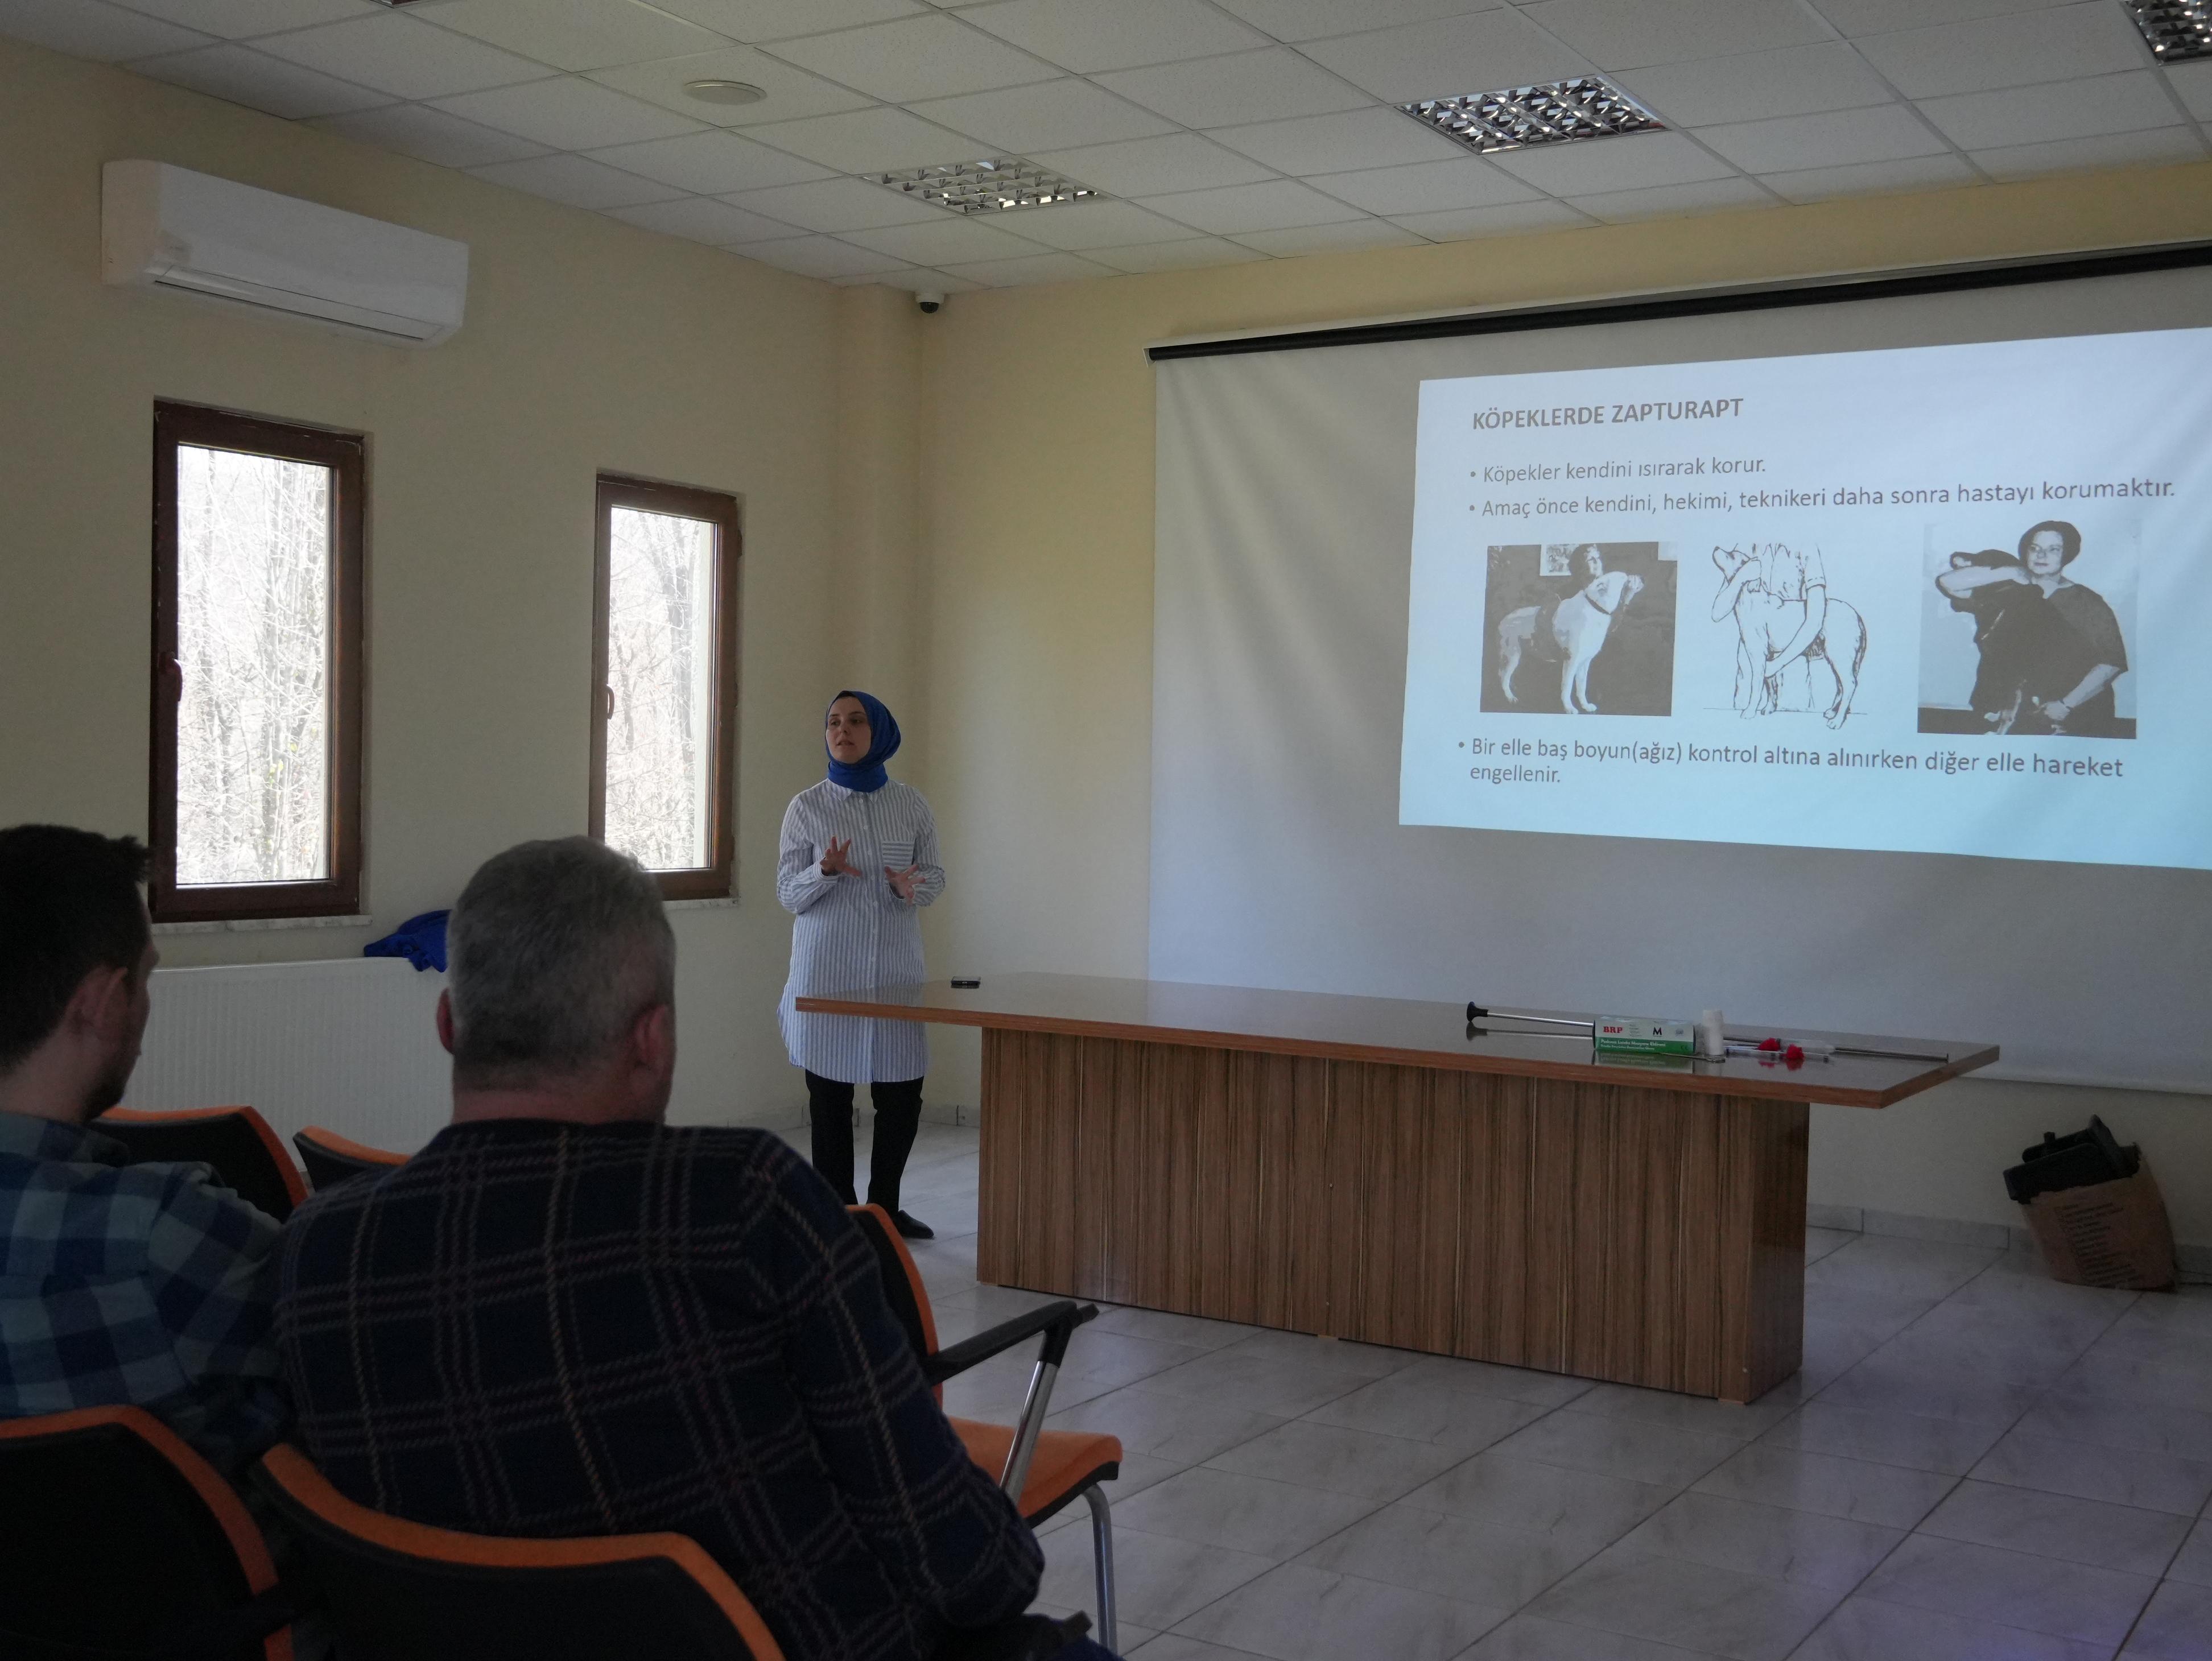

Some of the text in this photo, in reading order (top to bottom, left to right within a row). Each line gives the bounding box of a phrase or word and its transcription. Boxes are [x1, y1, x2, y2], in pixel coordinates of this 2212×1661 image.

[1473, 398, 1744, 430] KÖPEKLERDE ZAPTURAPT
[1484, 456, 1766, 486] Köpekler kendini ısırarak korur.
[1481, 477, 2175, 519] Amaç önce kendini, hekimi, teknikeri daha sonra hastayı korumaktır.
[1472, 738, 1496, 755] Bir
[1501, 738, 1532, 756] elle
[1538, 739, 1568, 761] baş
[1689, 743, 1757, 763] kontrol
[1764, 745, 1820, 766] altına
[1827, 747, 1917, 770] alınırken
[1925, 751, 1980, 775] diğer
[1986, 752, 2025, 772] elle
[2033, 753, 2123, 777] hareket
[1470, 764, 1561, 785] engellenir.
[1653, 1027, 1662, 1035] M
